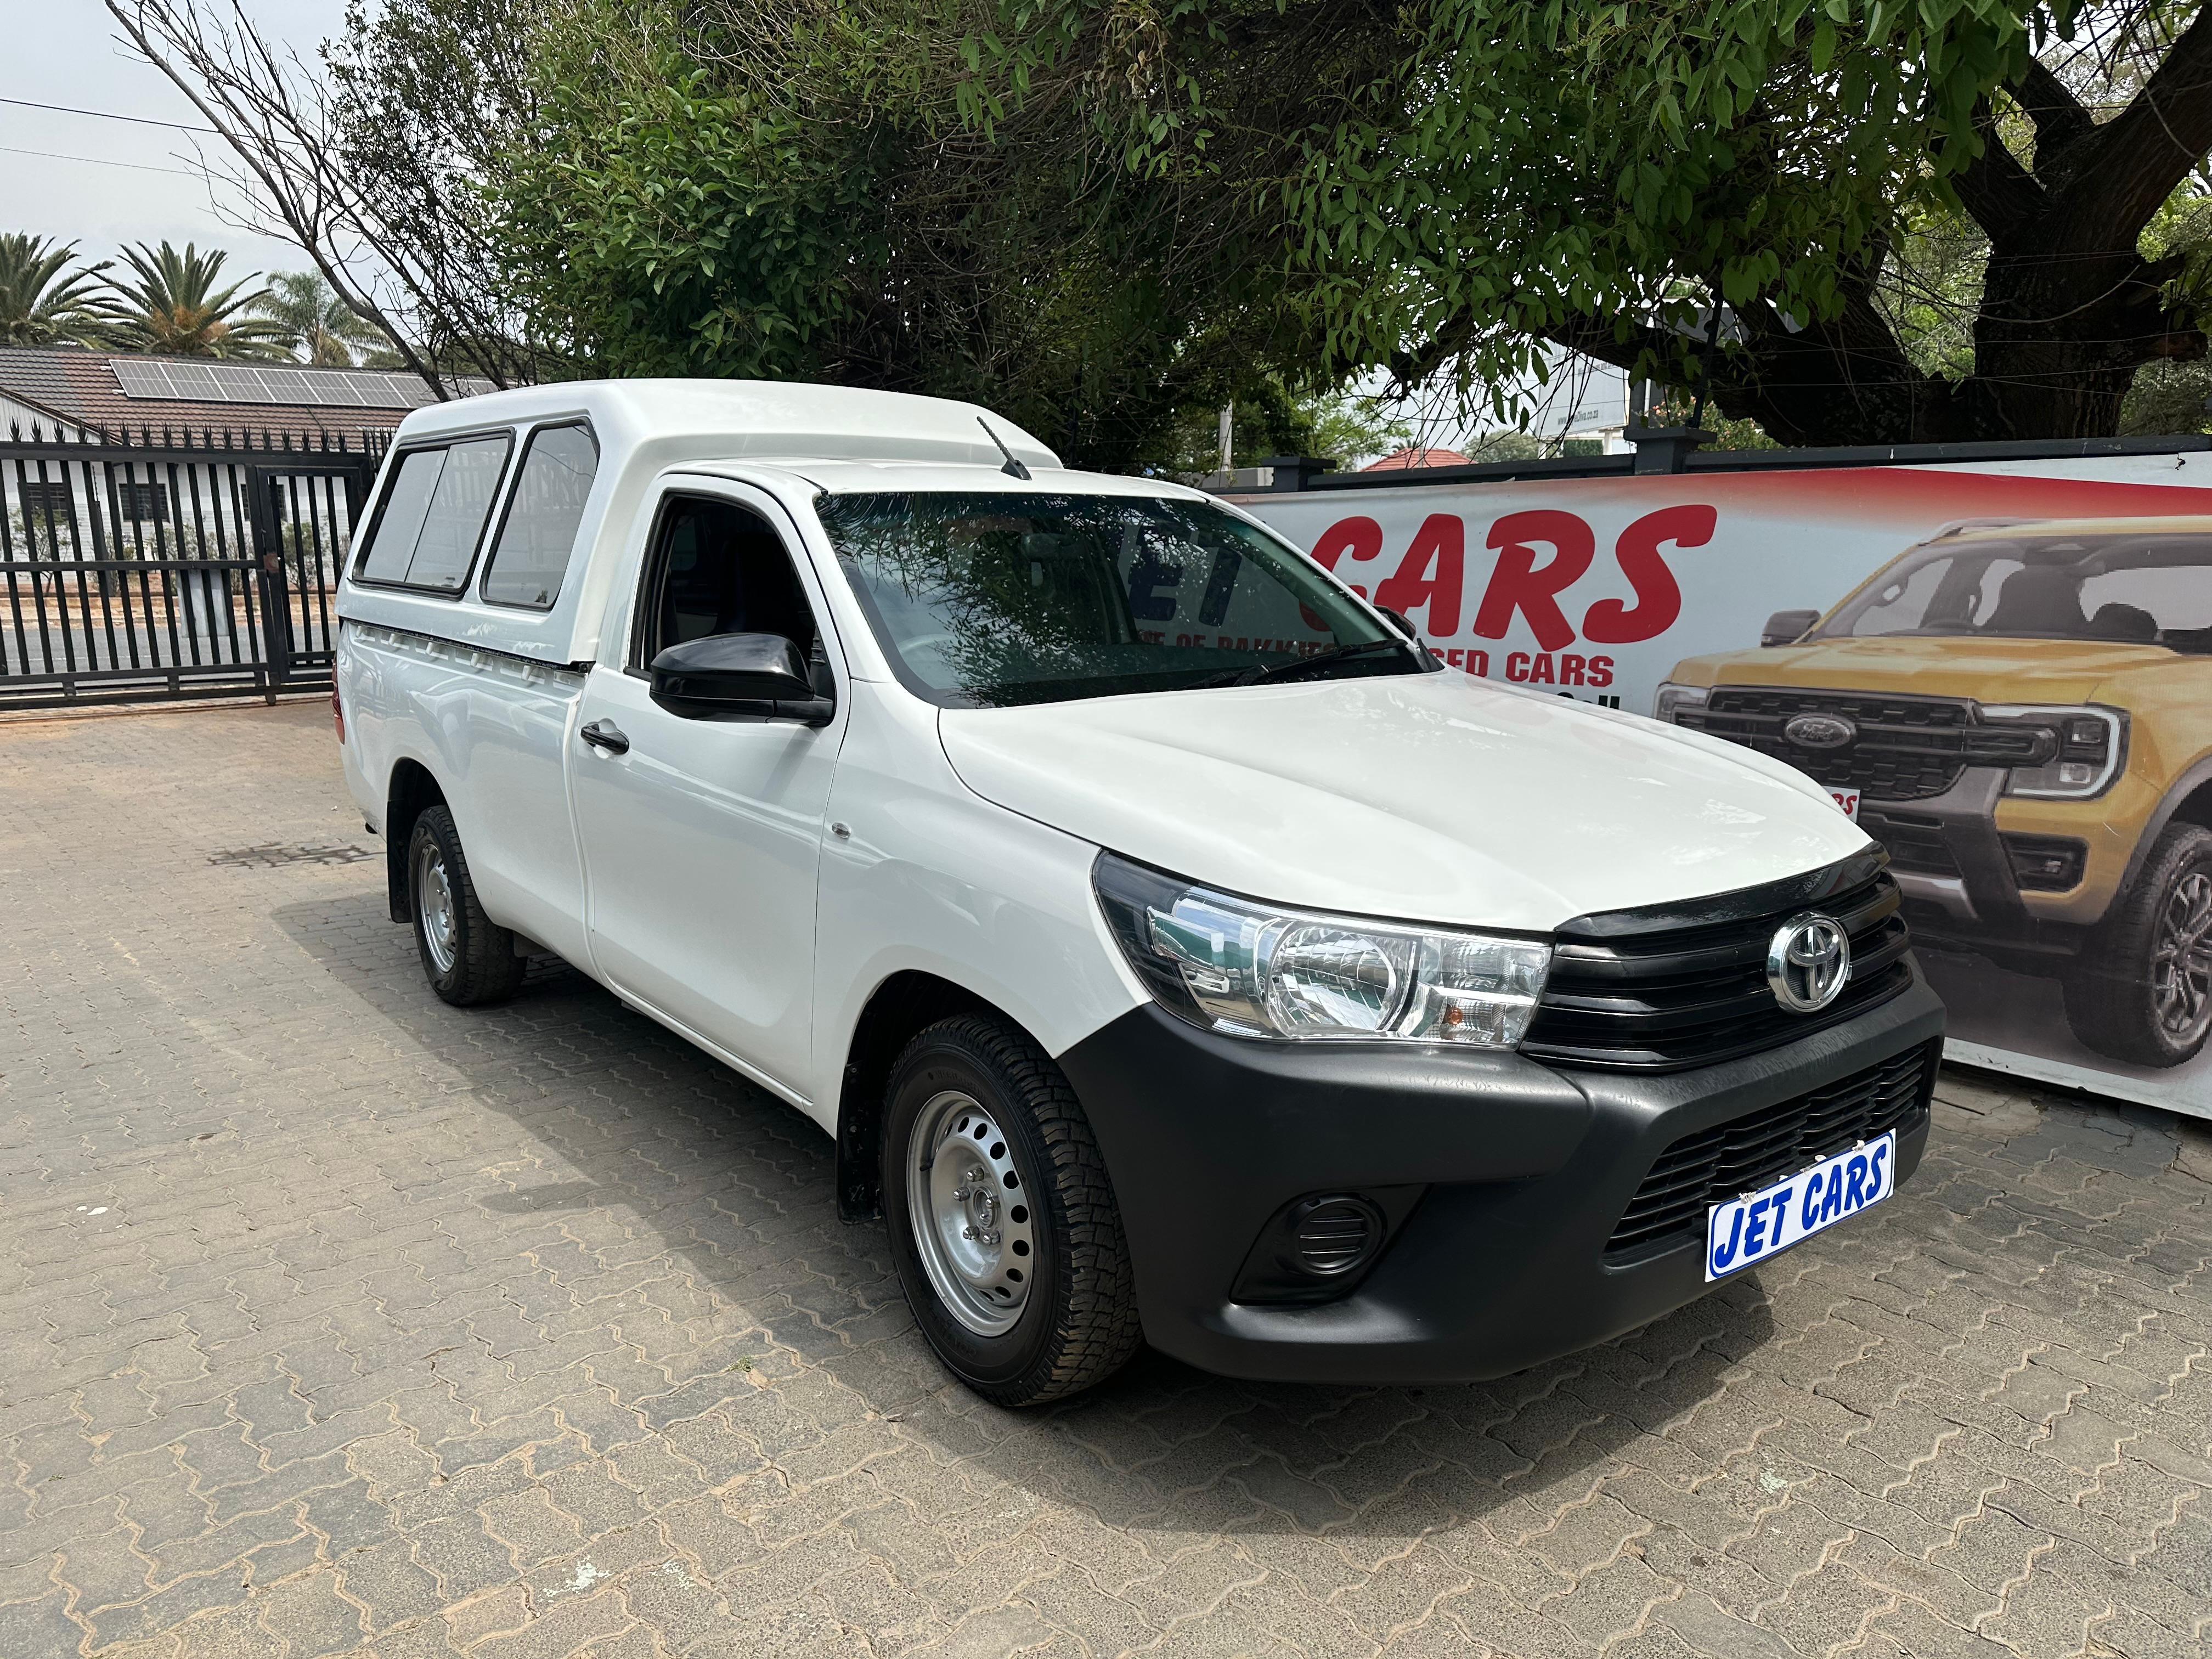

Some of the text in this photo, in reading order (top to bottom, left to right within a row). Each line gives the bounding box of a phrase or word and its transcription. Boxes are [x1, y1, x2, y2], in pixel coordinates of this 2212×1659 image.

[1298, 505, 1717, 652] CARS
[1505, 652, 1614, 687] CARS
[1714, 1143, 1887, 1268] JET CARS
